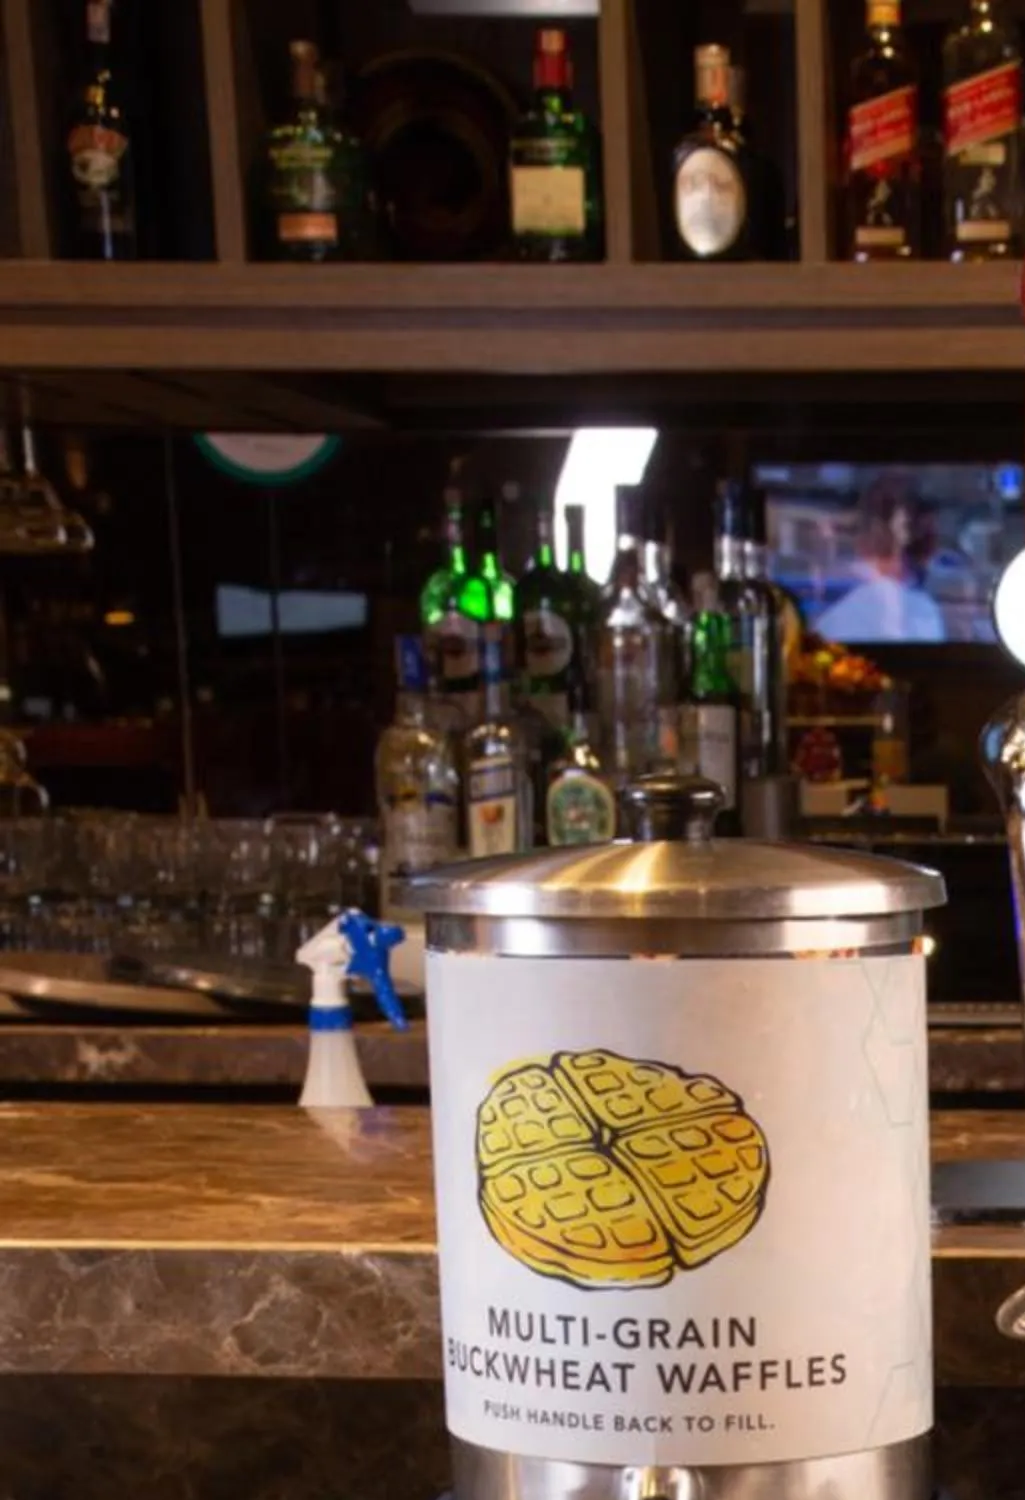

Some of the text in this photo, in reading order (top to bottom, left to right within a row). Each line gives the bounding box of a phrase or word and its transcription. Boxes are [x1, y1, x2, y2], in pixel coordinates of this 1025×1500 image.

[487, 1305, 756, 1350] MULTI-GRAIN
[448, 1337, 847, 1394] BUCKWHEAT WAFFLES
[484, 1399, 777, 1434] PUSH HANDLE BACK TO FILL.
